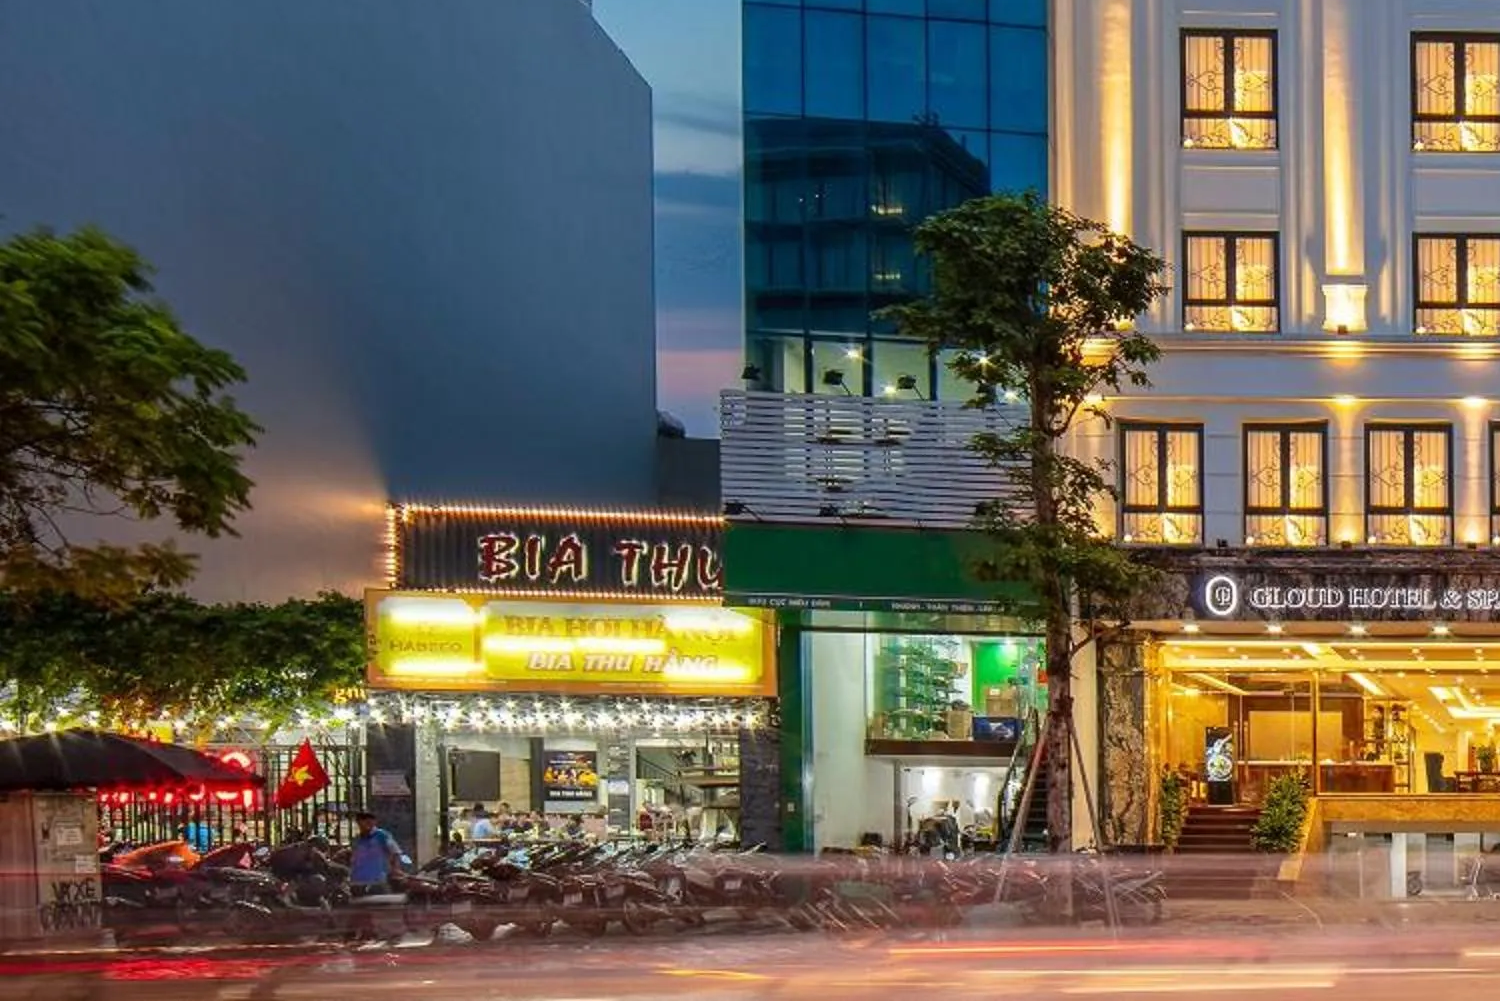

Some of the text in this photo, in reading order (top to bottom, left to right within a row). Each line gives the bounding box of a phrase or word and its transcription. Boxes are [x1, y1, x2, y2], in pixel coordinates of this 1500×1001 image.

[478, 532, 588, 582] BIA
[1250, 586, 1344, 610] GLOUD
[1348, 587, 1436, 610] HOTEL
[1439, 587, 1463, 610] &
[526, 653, 578, 672] BIA
[582, 654, 635, 673] THU
